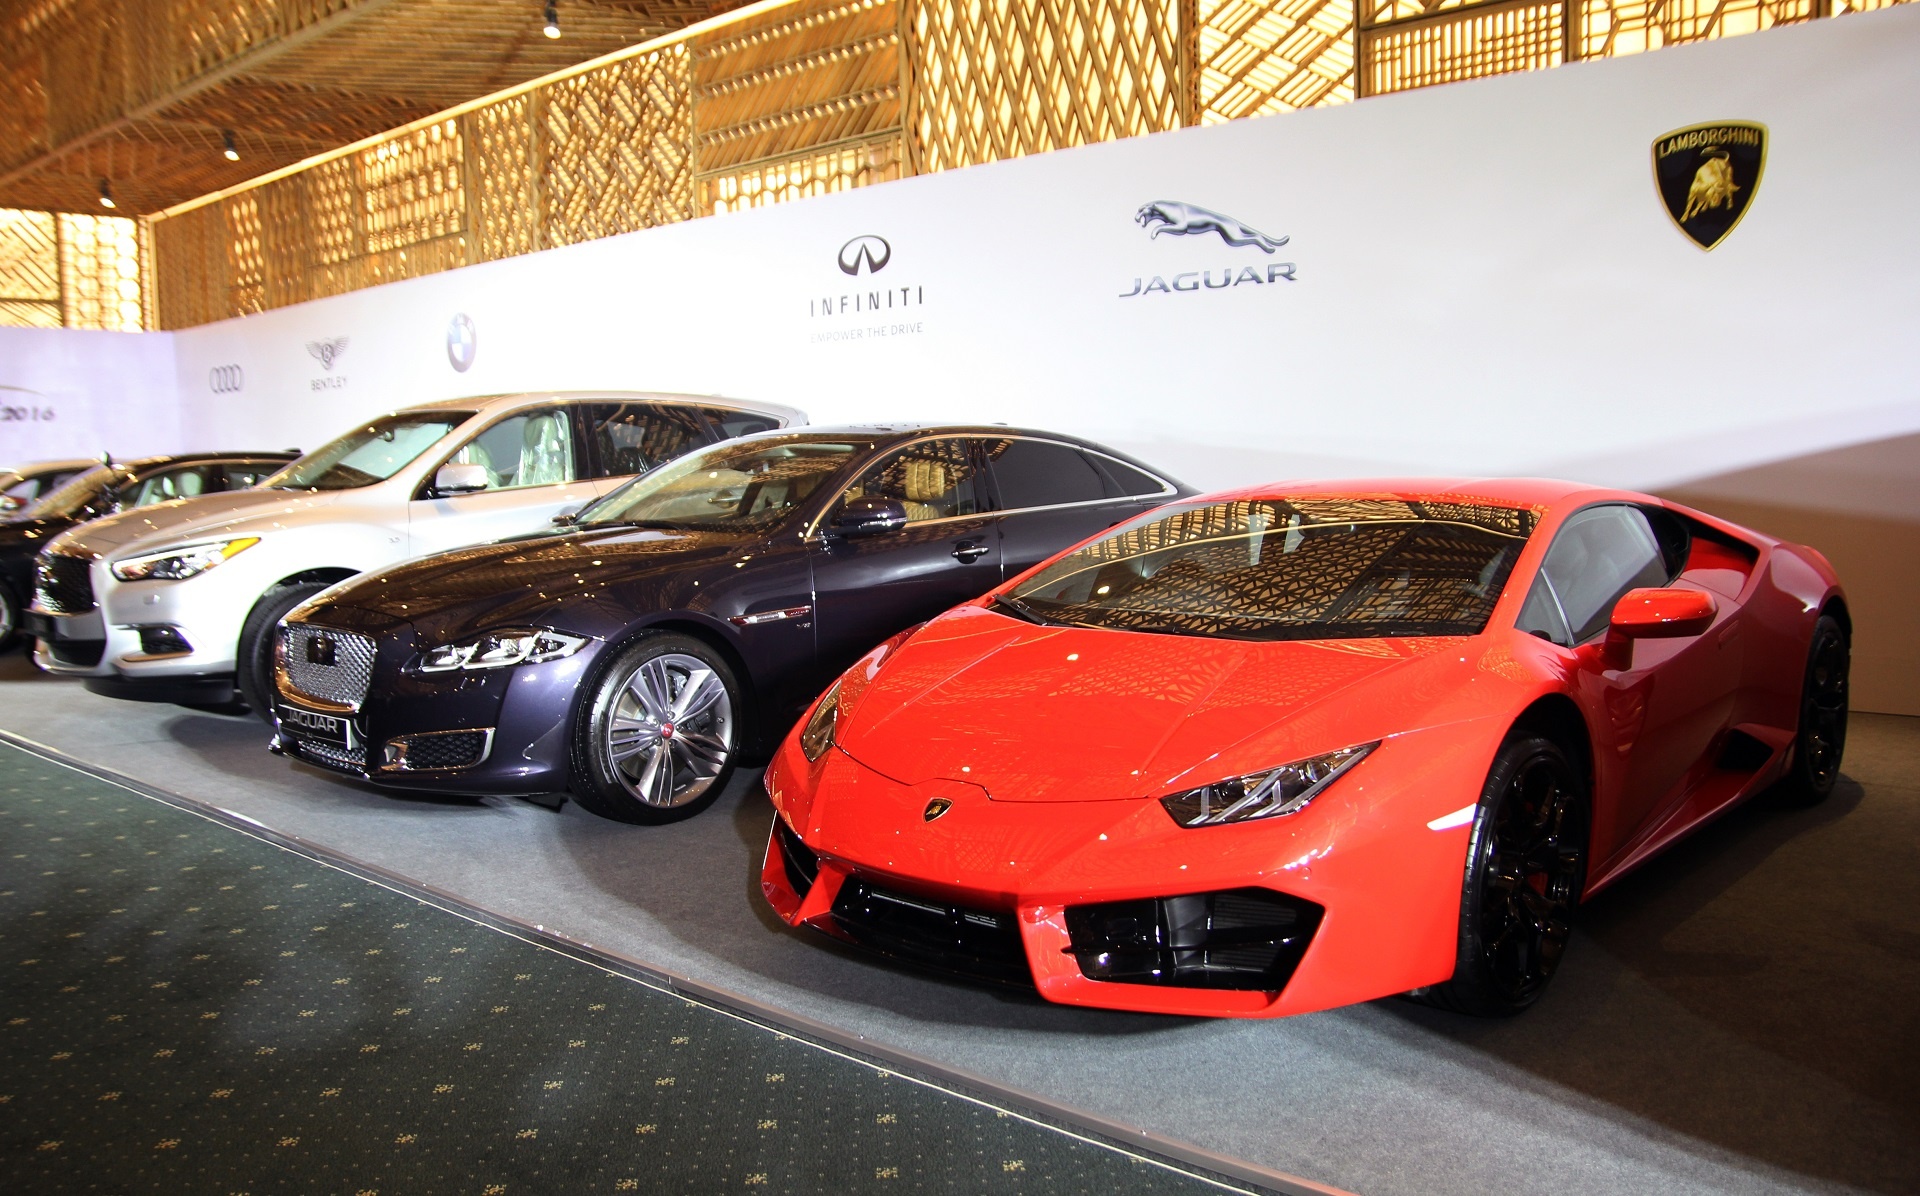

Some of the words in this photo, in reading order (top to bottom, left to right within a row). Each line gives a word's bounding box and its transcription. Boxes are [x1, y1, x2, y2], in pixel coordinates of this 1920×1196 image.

[1659, 127, 1759, 159] LAMBORGHINI
[1118, 262, 1298, 297] JAGUAR
[810, 285, 922, 317] INFINITI
[809, 328, 863, 344] EMPOWER
[866, 325, 888, 338] THE
[891, 322, 924, 336] DRIVE
[310, 376, 347, 391] BENTLEY
[0, 405, 55, 422] 2016
[286, 708, 339, 734] JAGUAR
